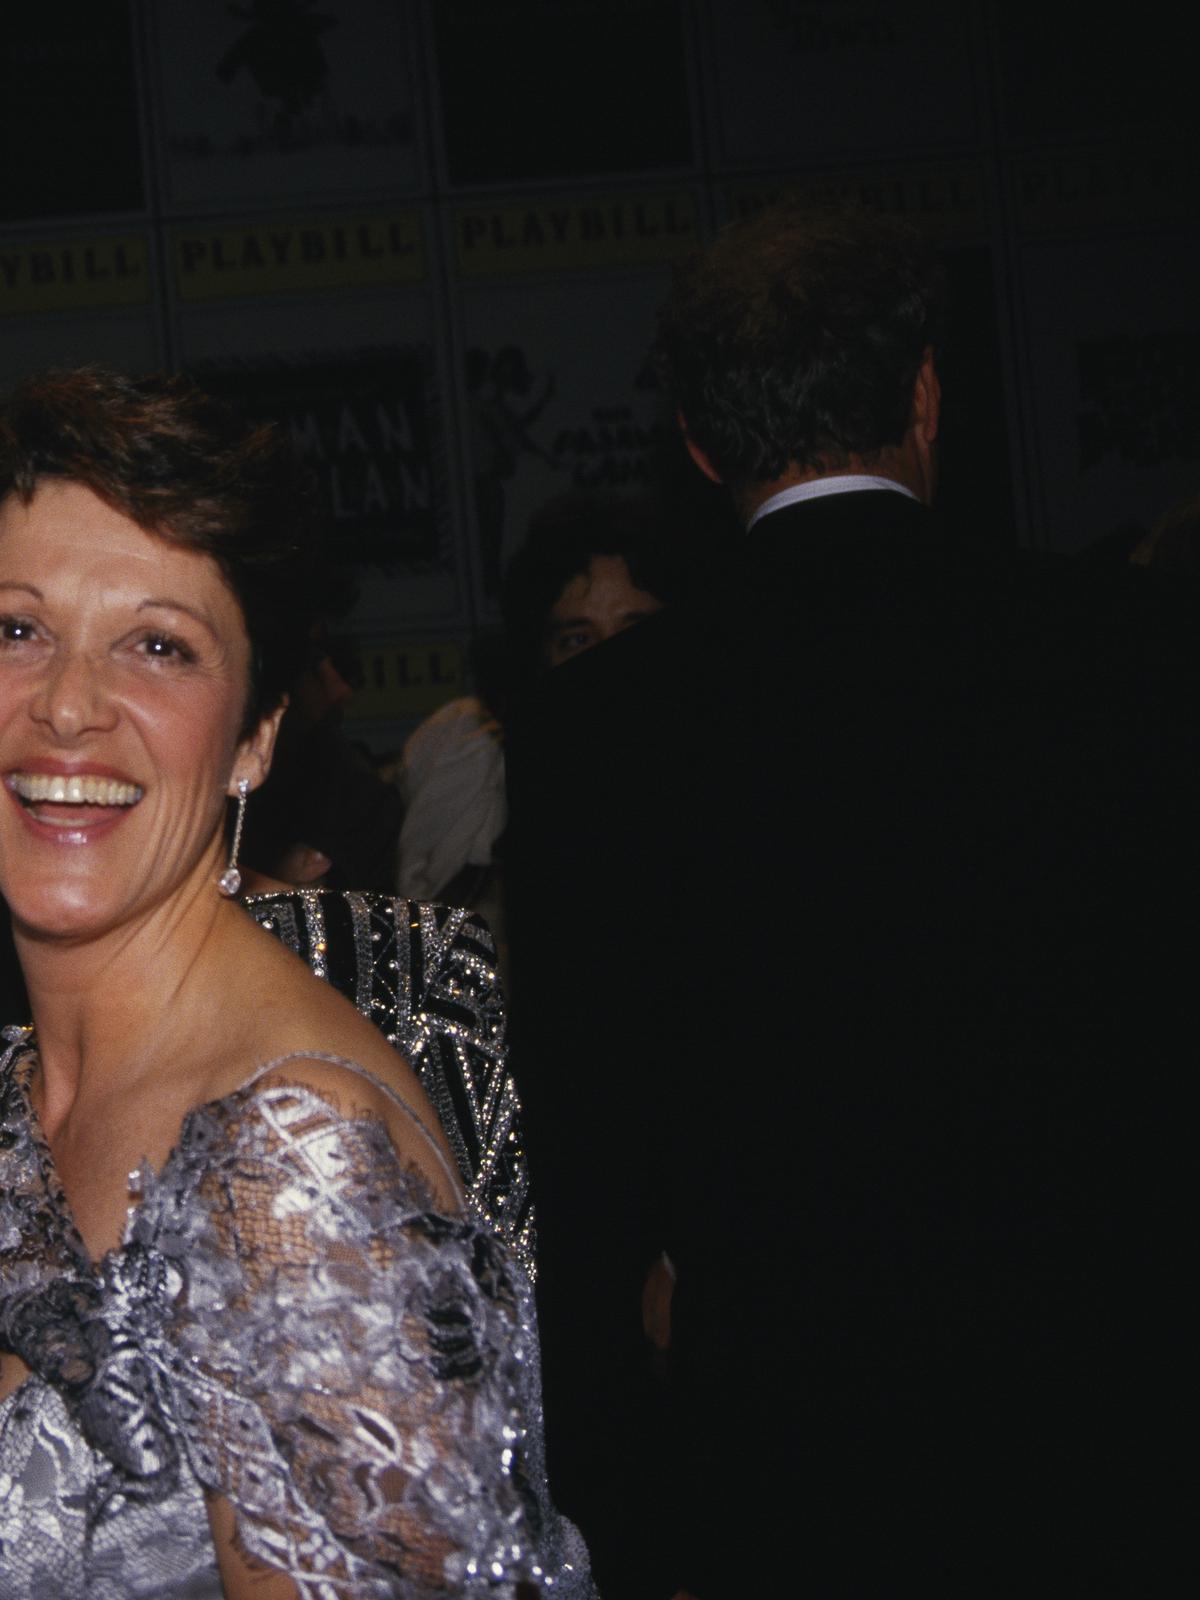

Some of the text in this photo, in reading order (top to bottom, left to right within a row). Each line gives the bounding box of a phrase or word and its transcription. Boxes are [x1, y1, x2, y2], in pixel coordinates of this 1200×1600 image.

[180, 223, 417, 273] PLAYBILL
[461, 200, 691, 250] PLAYBILL
[329, 459, 431, 519] LAN
